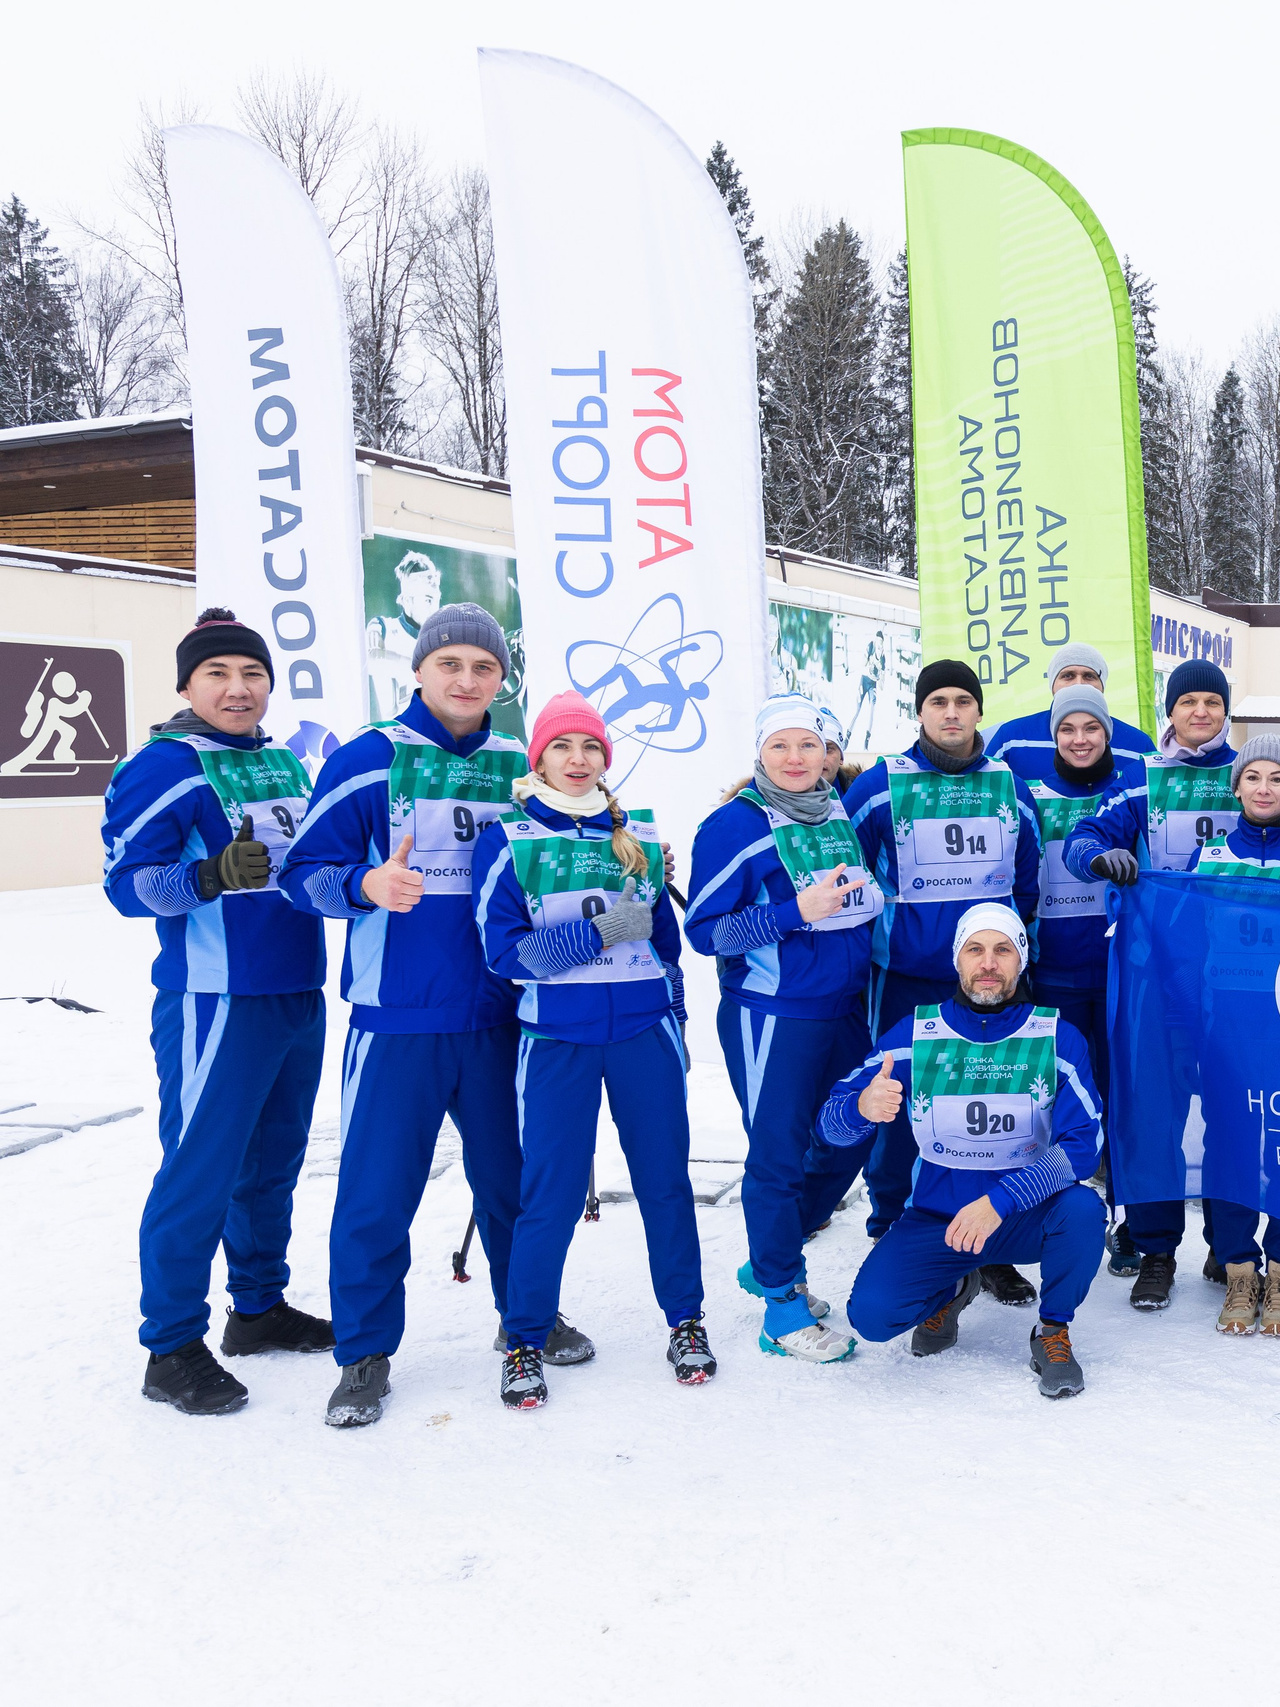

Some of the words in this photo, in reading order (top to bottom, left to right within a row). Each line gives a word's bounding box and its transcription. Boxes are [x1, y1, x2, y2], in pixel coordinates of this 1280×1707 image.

[1151, 613, 1233, 668] ИНСТРОЙ
[447, 762, 478, 770] ГОНКА
[574, 860, 624, 870] ДИВИЗИОН
[425, 868, 471, 877] РОСАТО
[926, 877, 972, 887] РОСАТОМ
[1053, 894, 1096, 905] РОСАТОМ
[574, 957, 613, 966] АТОМ
[1220, 969, 1264, 977] РОСАТОМ
[964, 1064, 1028, 1072] ДИВИЗИОНОВ
[945, 1147, 994, 1159] РОСАТОМ
